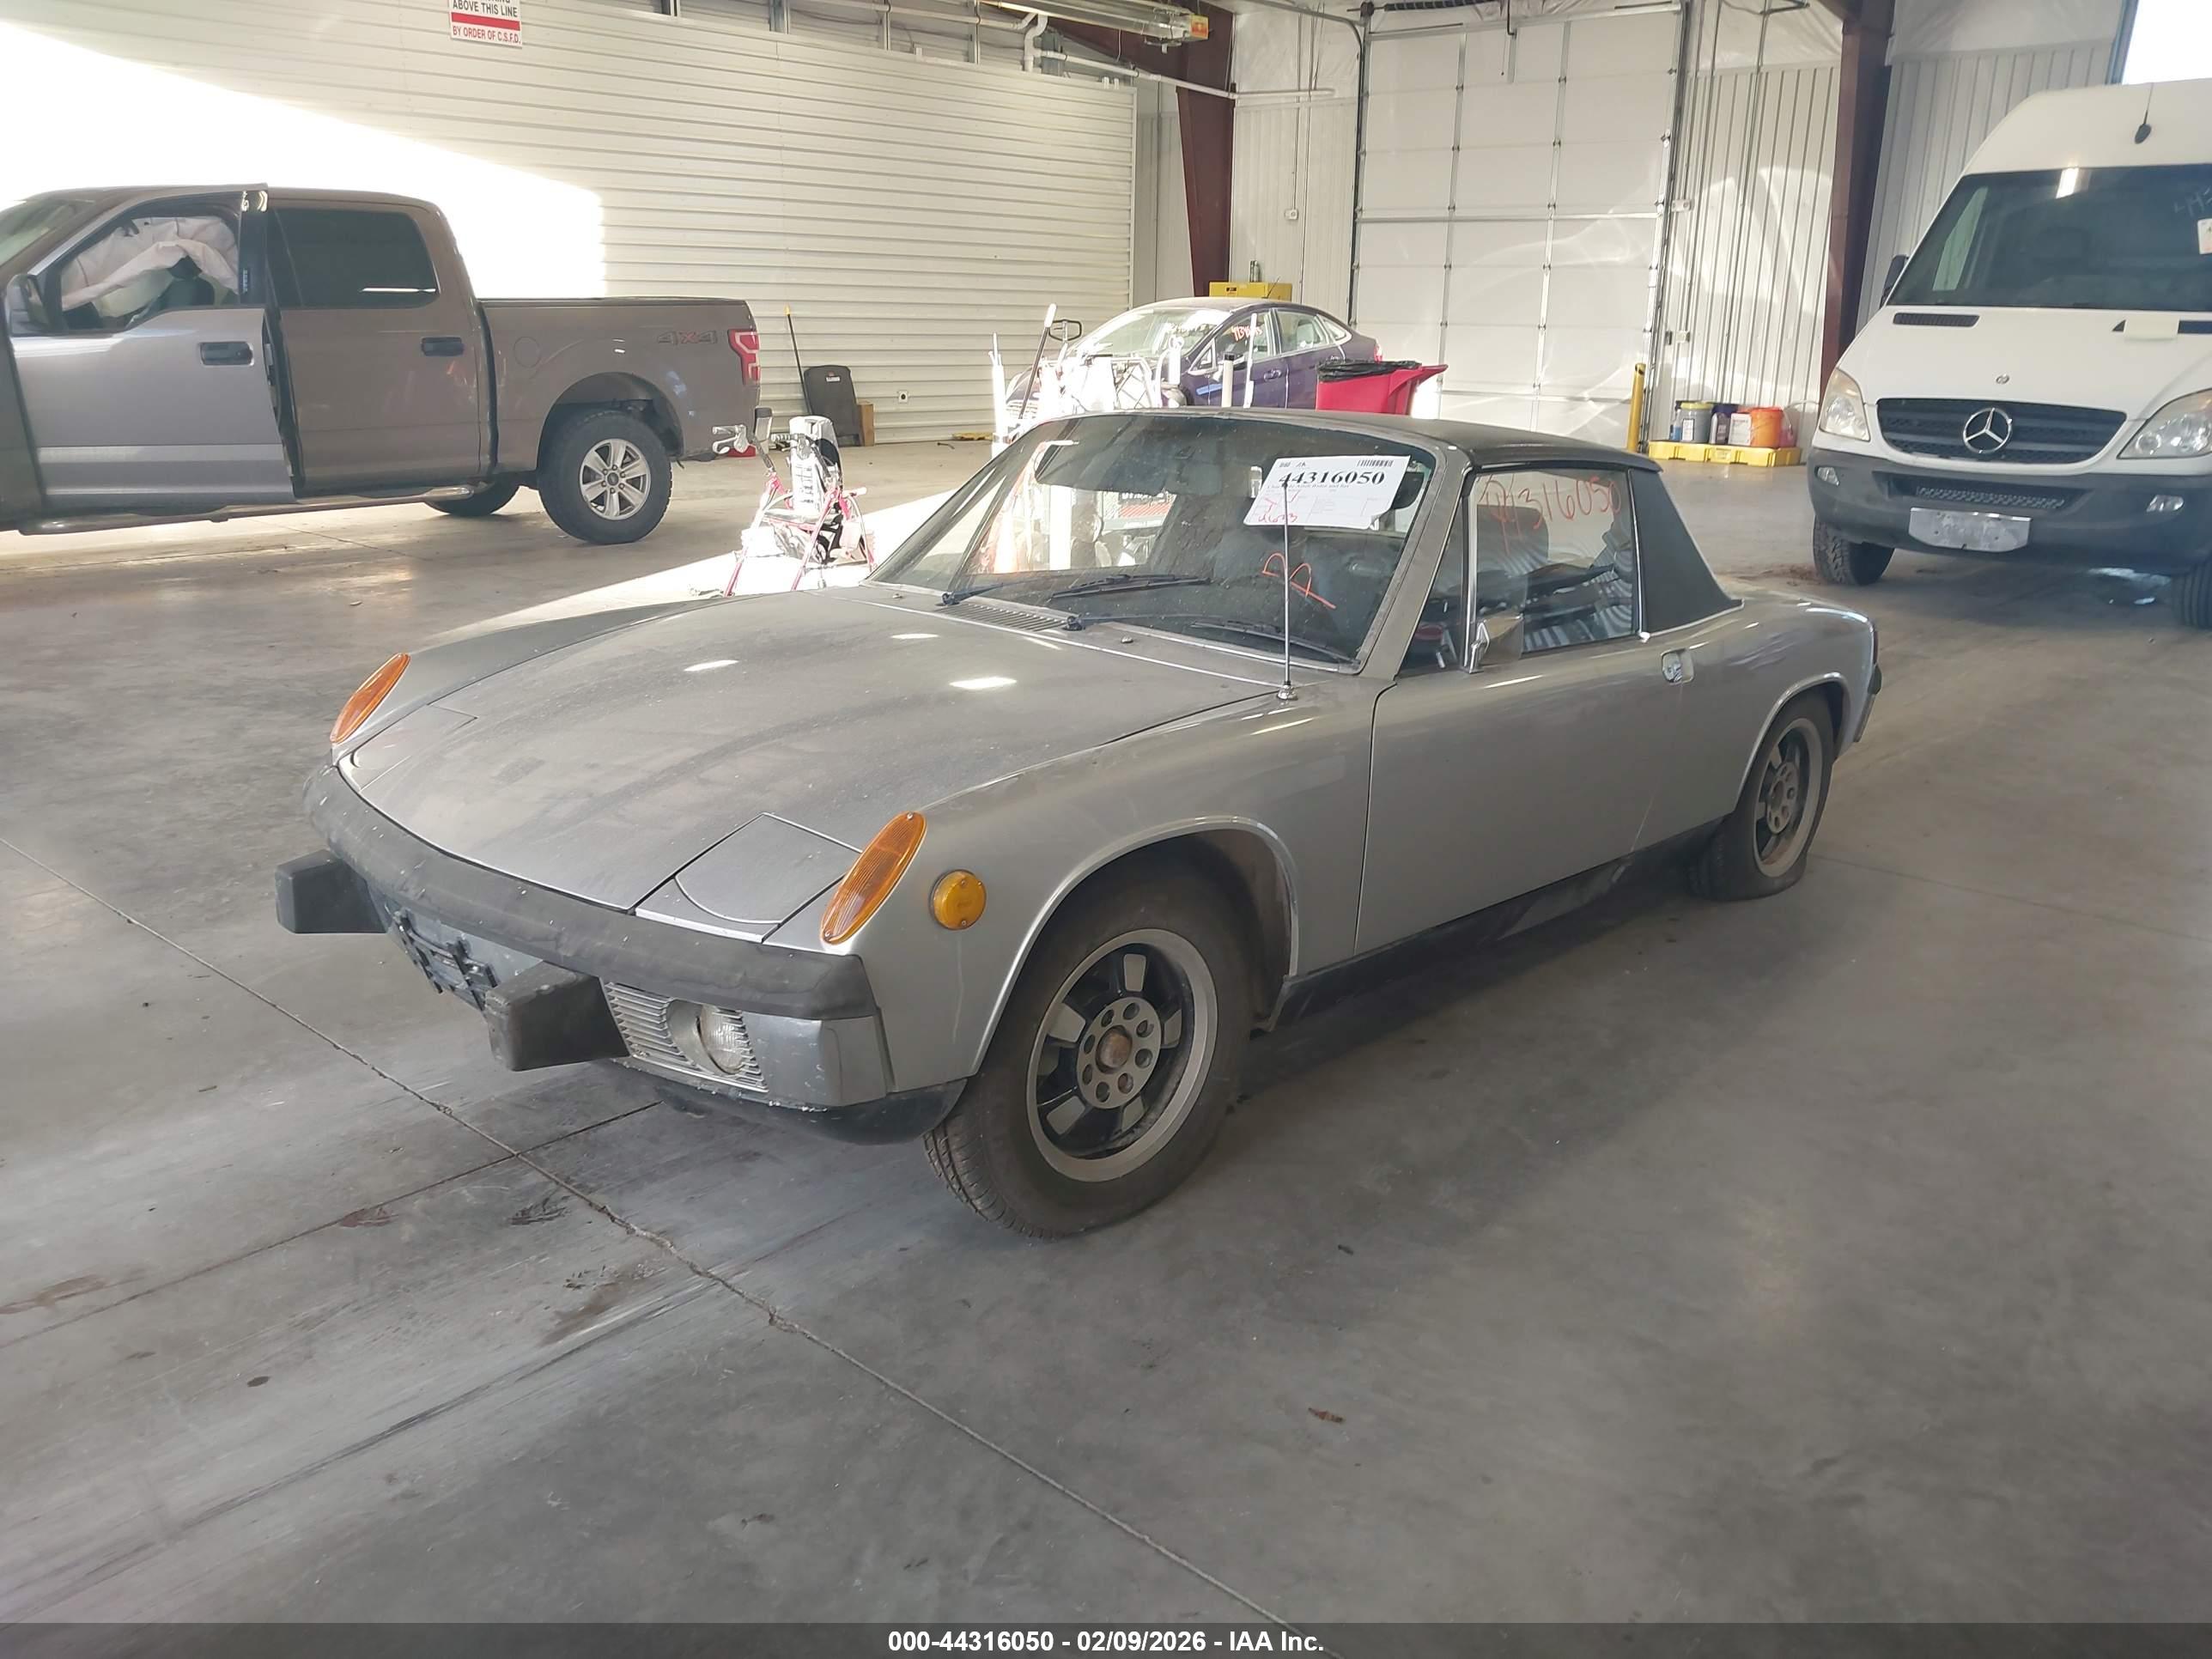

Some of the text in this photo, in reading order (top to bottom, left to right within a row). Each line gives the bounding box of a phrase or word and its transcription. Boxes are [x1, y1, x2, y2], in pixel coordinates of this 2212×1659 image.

[453, 0, 518, 17] ABOVE THIS LINE
[453, 26, 461, 36] BY
[463, 27, 486, 40] ORDER
[488, 30, 496, 40] OF
[1278, 471, 1386, 485] 44316050
